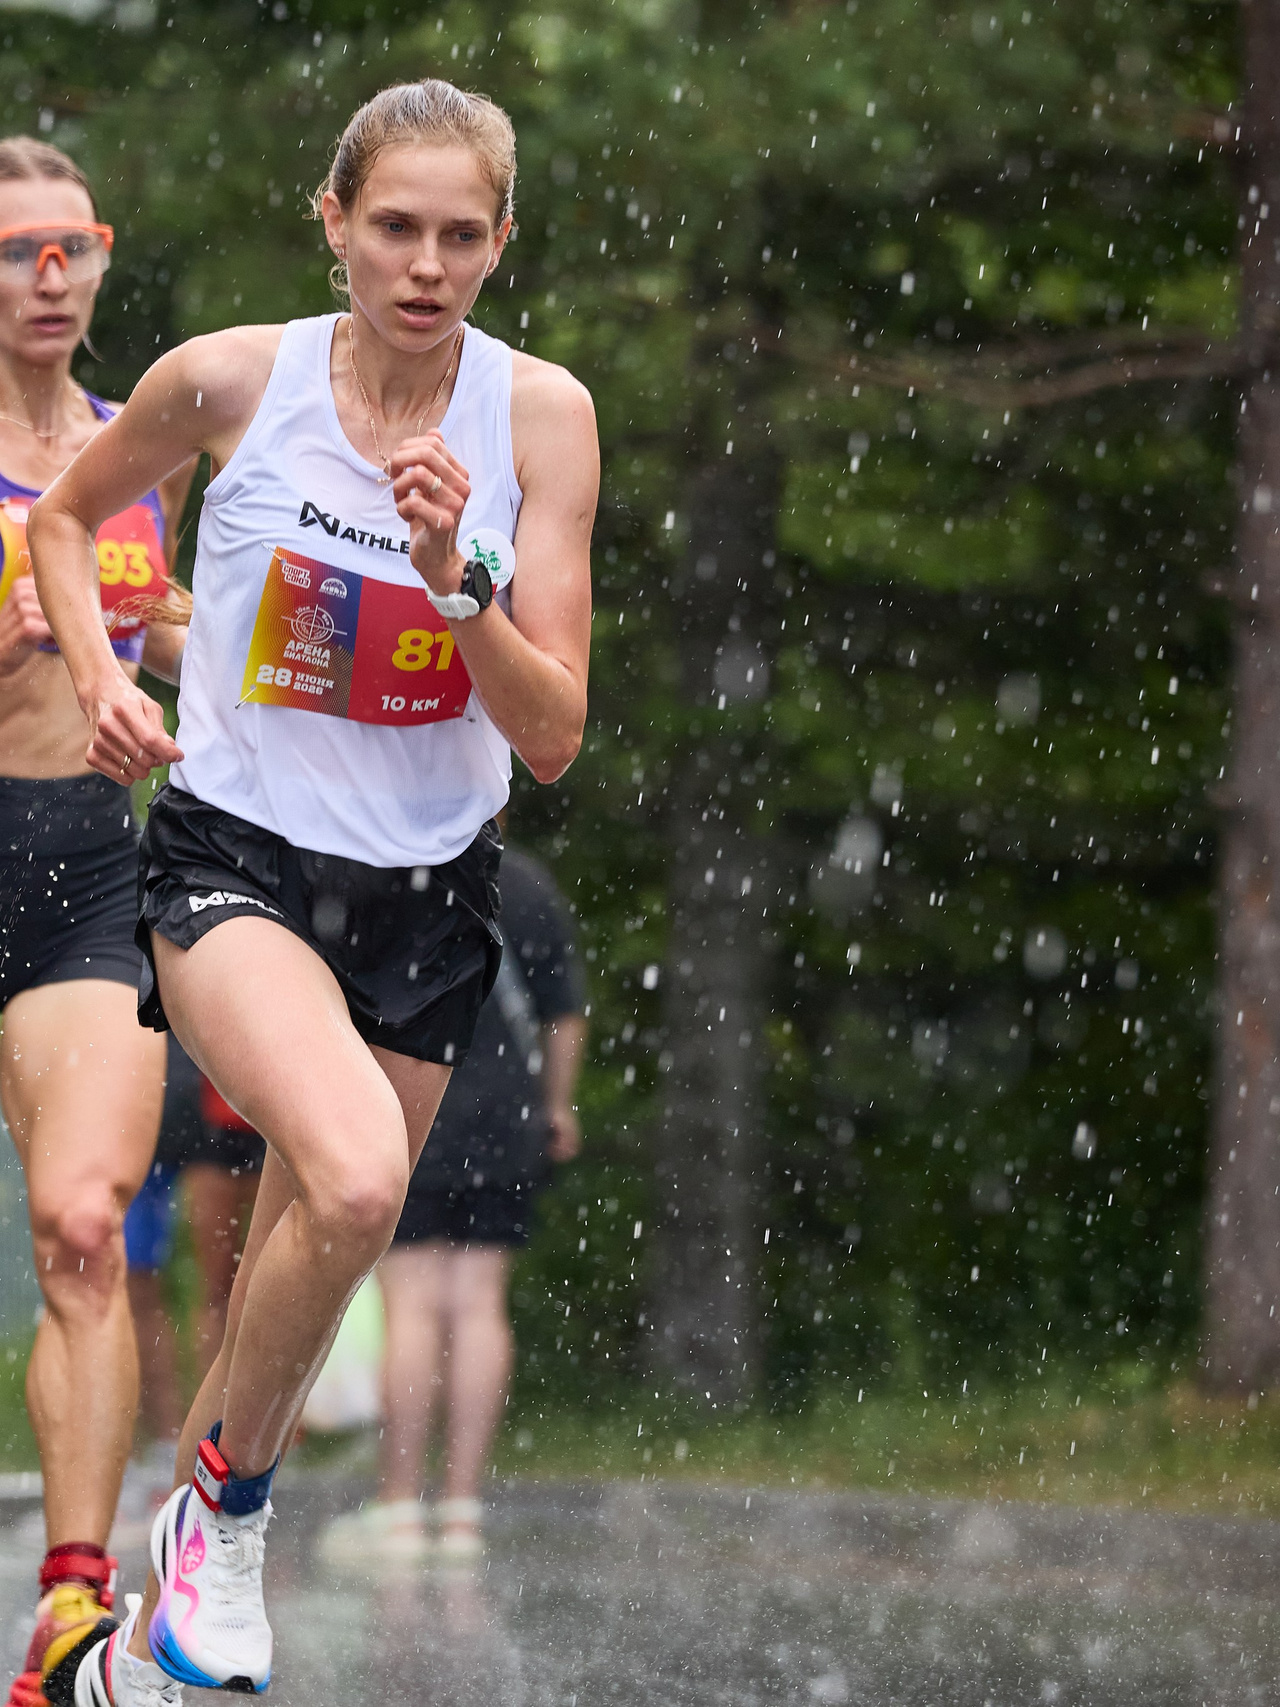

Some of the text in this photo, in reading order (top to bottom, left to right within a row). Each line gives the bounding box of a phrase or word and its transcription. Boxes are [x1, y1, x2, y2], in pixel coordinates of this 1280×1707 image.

[95, 539, 154, 588] 93
[283, 650, 329, 669] БИАТЛОНА
[285, 639, 331, 661] АРЕНА
[391, 628, 455, 672] 81
[256, 664, 335, 689] 28 ИЮНЯ
[381, 695, 406, 712] 10
